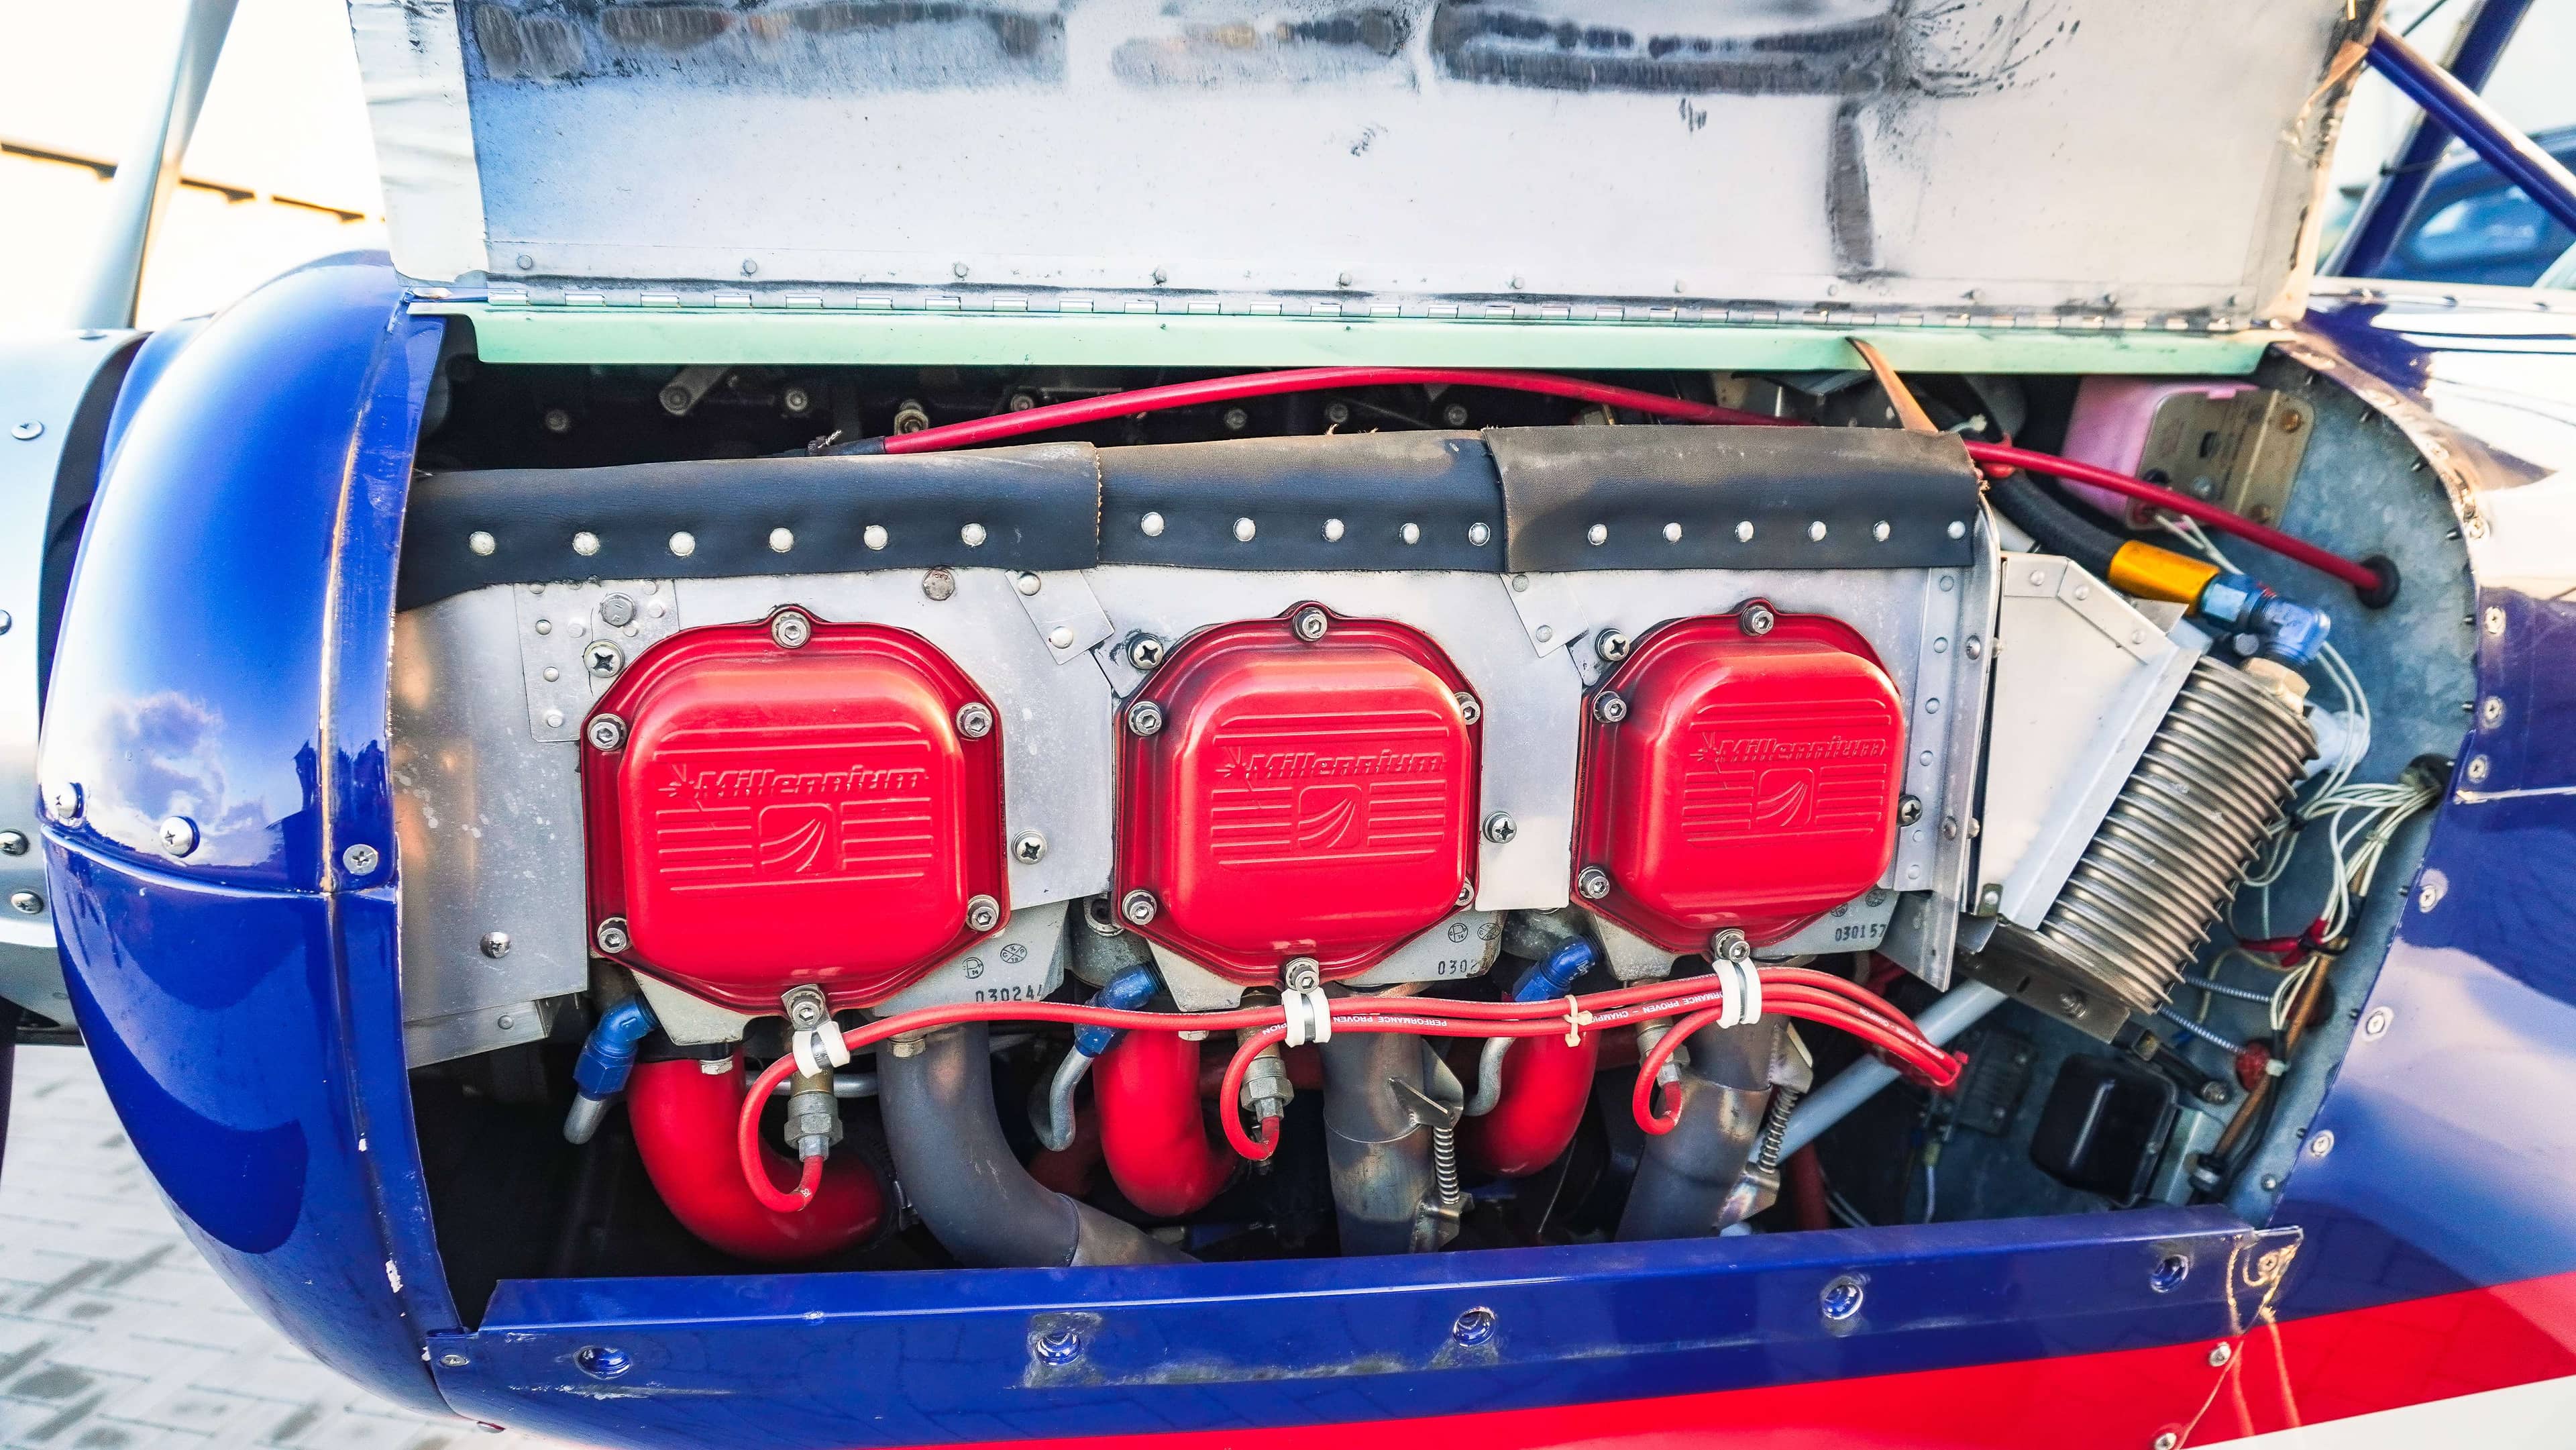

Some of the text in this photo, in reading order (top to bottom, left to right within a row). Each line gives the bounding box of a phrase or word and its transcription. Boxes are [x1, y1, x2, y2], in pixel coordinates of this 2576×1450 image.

[1715, 735, 1886, 763] Millennium
[1246, 749, 1444, 779] Millennium
[694, 765, 927, 798] Millennium
[1643, 1000, 1680, 1013] PROVEN
[1377, 1016, 1448, 1027] PERFORMANCE
